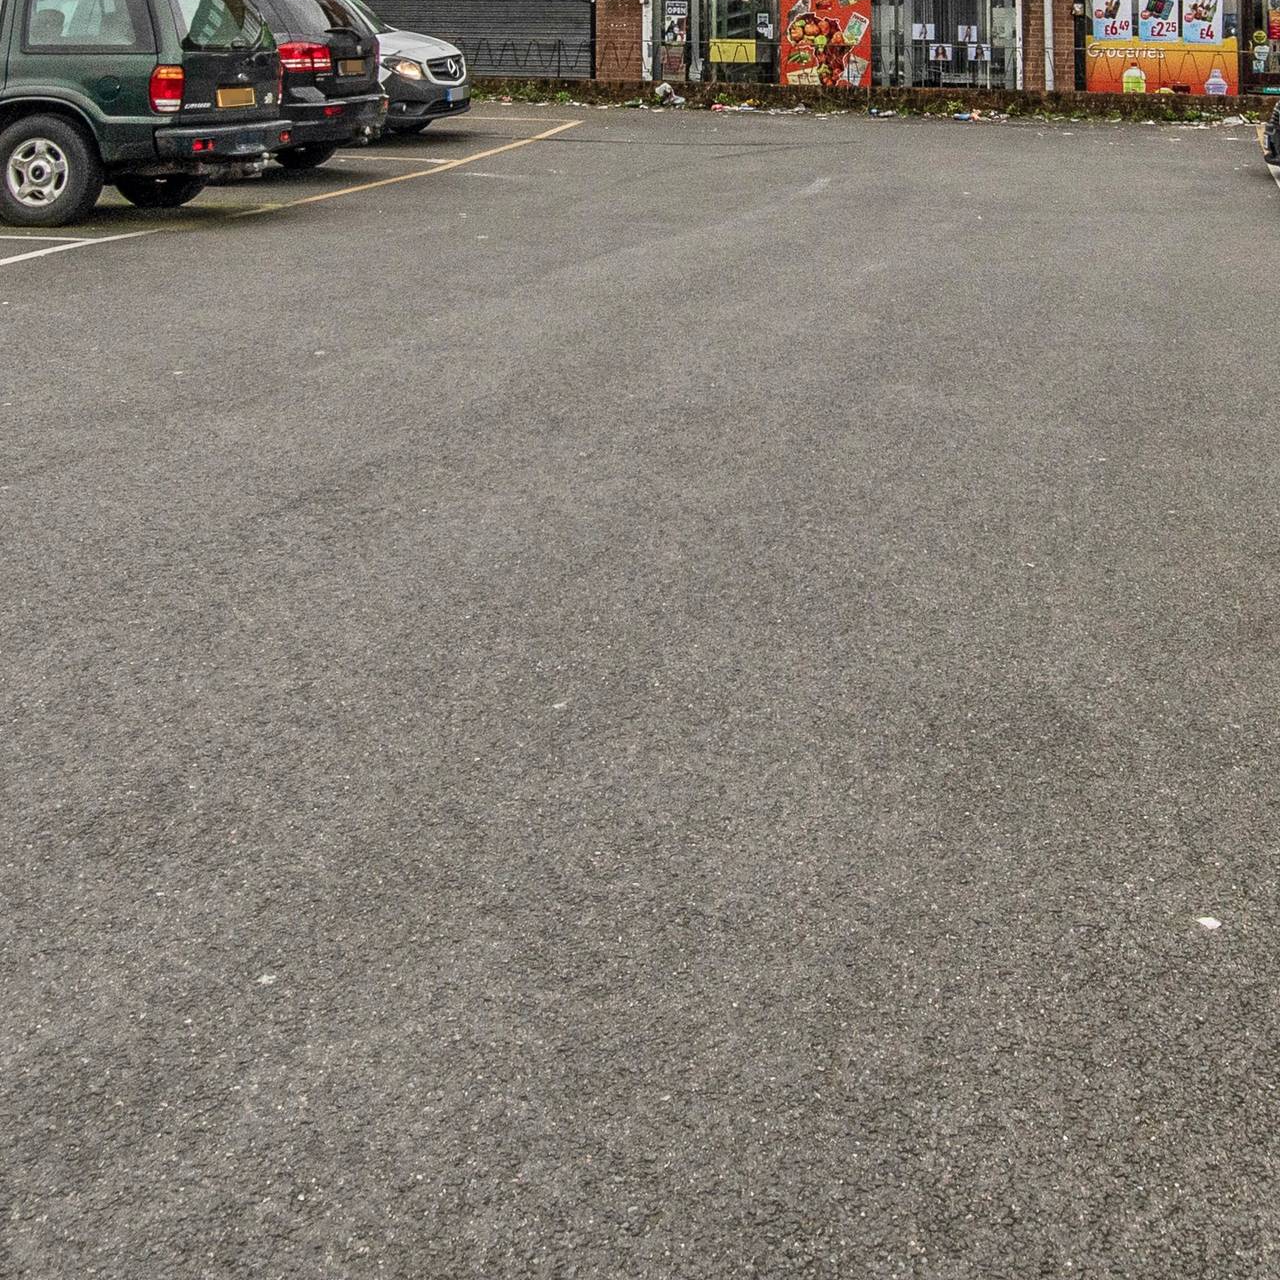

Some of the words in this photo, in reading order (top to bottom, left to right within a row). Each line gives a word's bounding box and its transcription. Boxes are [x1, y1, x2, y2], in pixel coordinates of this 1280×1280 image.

[667, 6, 687, 15] OPEN
[1104, 20, 1130, 36] £6.49
[1200, 24, 1215, 40] £4
[1087, 42, 1166, 59] Groceries
